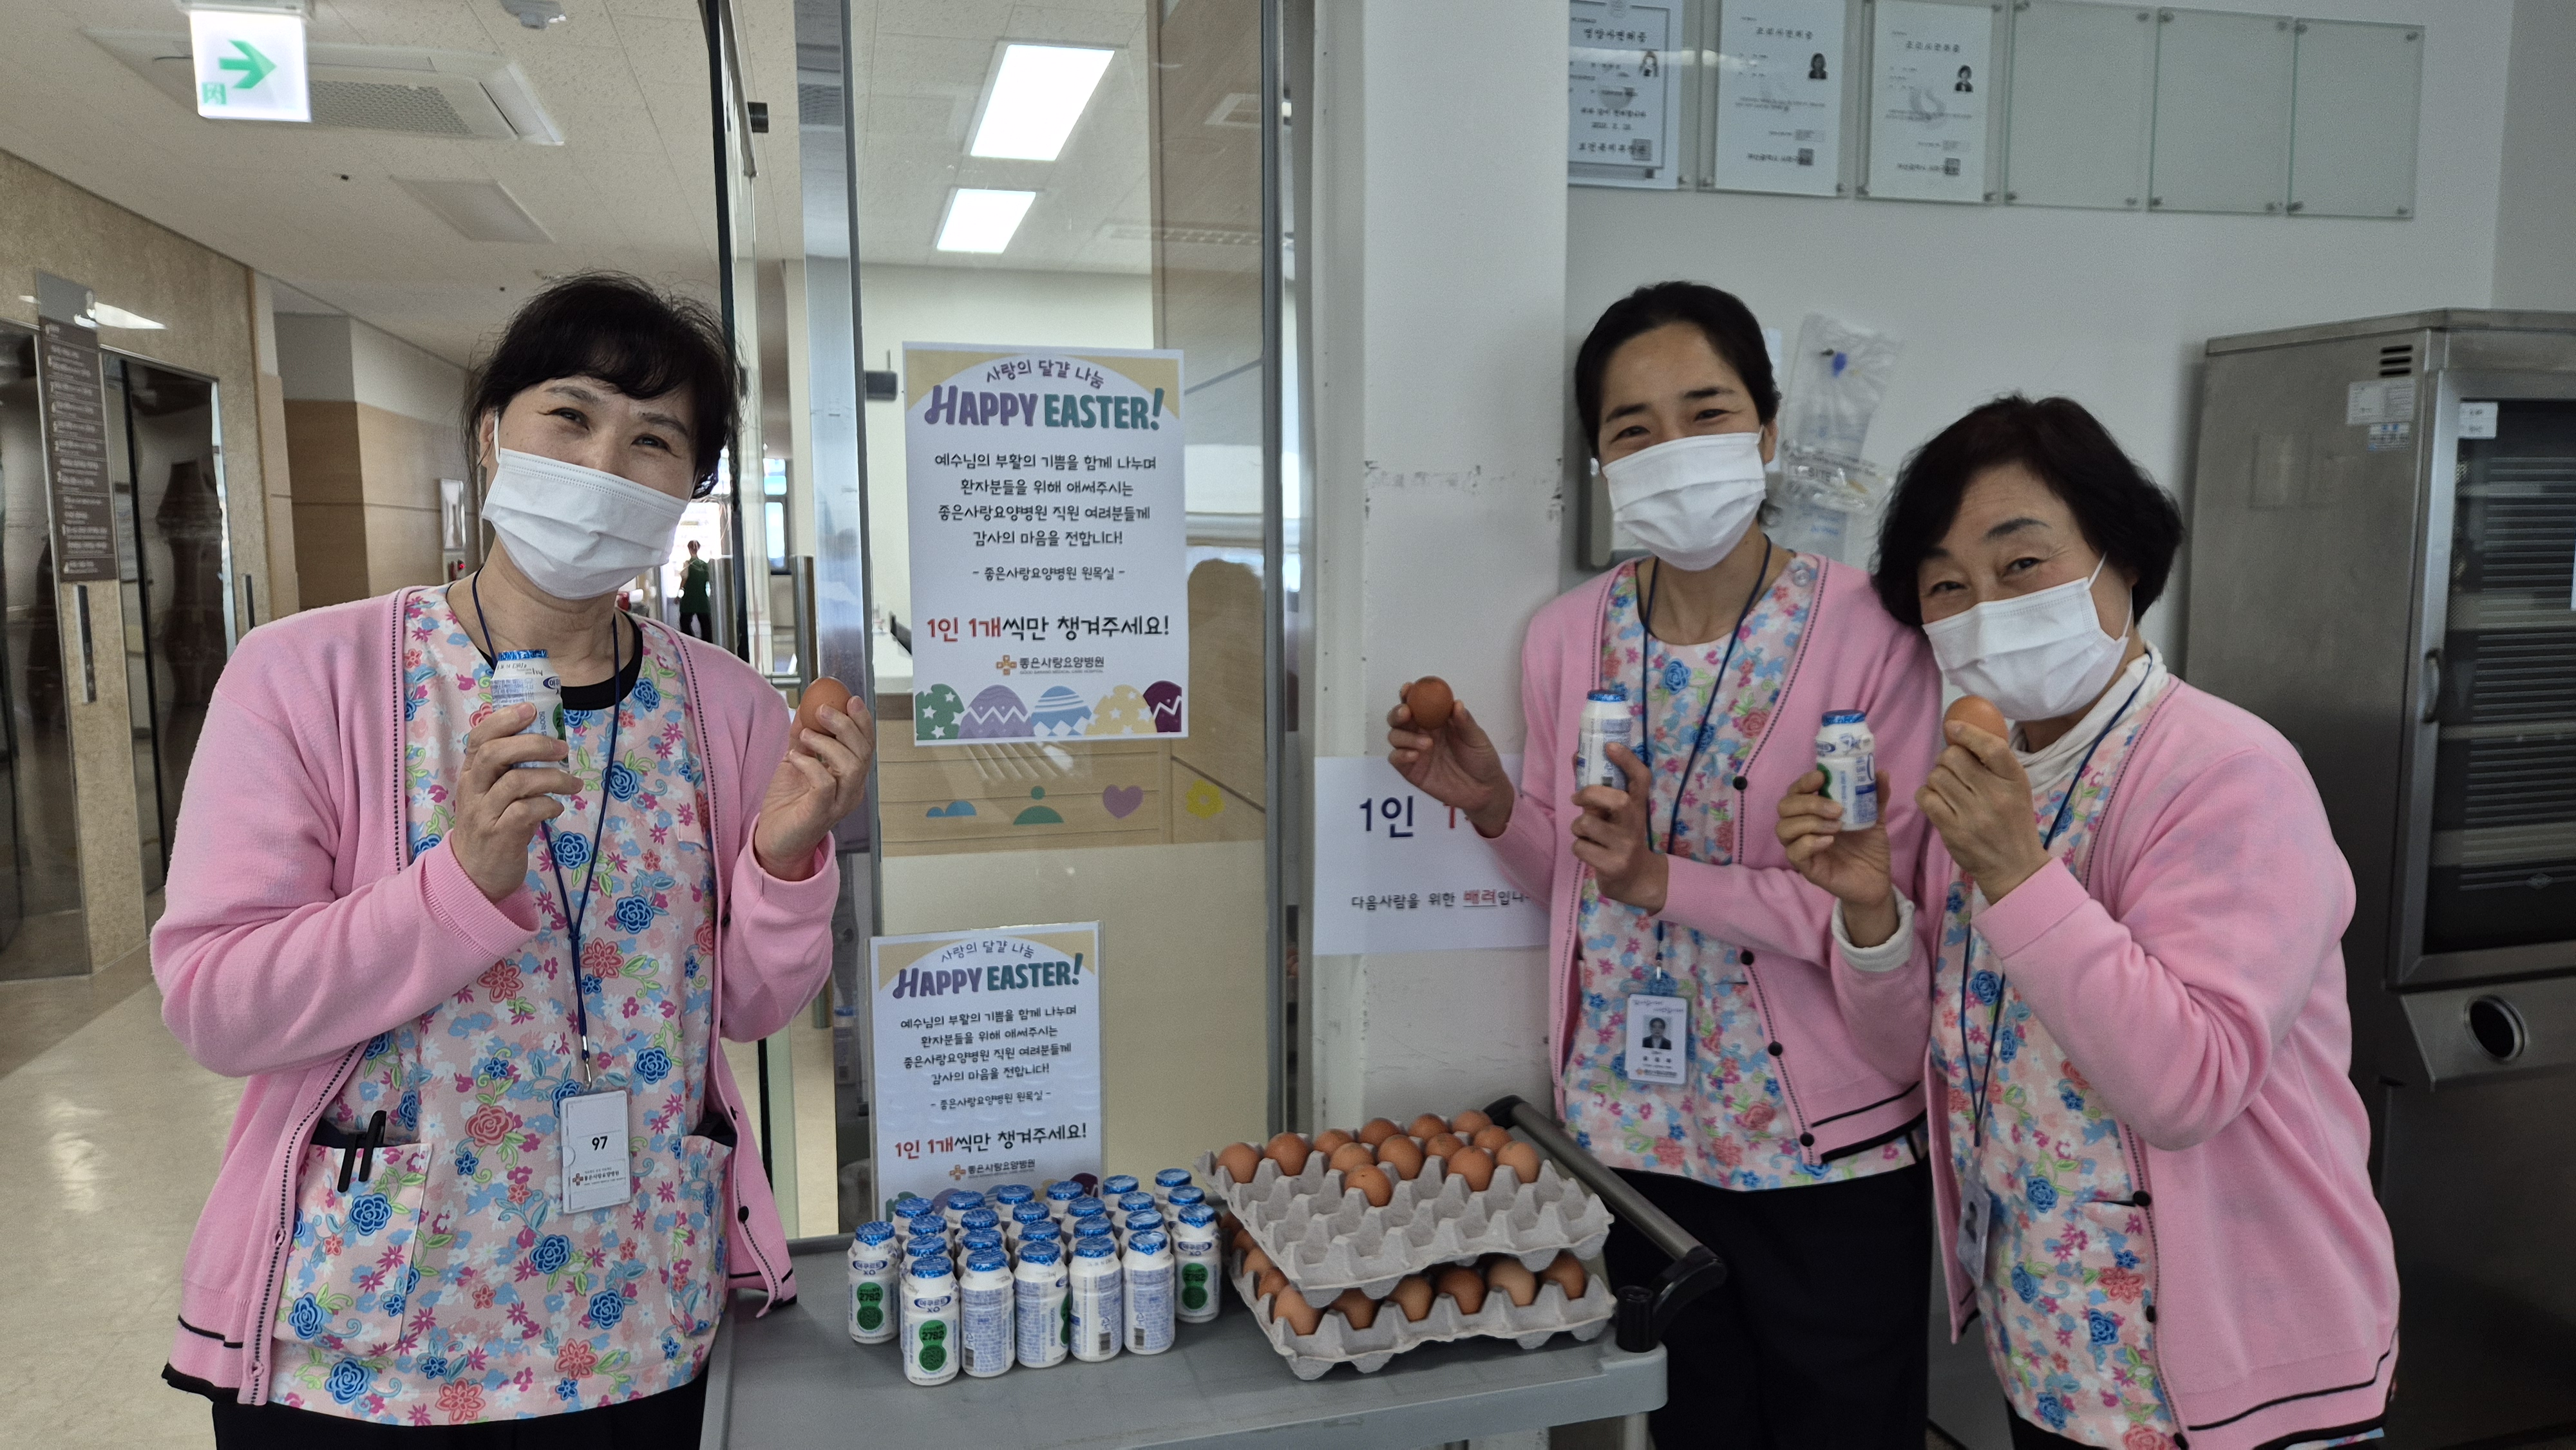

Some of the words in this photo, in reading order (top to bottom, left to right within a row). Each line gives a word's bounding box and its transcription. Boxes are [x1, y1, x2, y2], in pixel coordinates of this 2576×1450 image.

[987, 359, 1032, 383] 사랑의
[1038, 359, 1071, 379] 달걀
[1075, 366, 1104, 390] 나눔
[924, 384, 1038, 426] HAPPY
[1044, 388, 1165, 431] EASTER!
[934, 453, 990, 469] 예수님의
[996, 453, 1036, 470] 부활의
[1041, 454, 1079, 471] 기쁨을
[1084, 455, 1112, 471] 함께
[1117, 455, 1156, 471] 나누며
[961, 478, 1028, 496] 환자분들을
[1034, 480, 1061, 494] 위해
[1066, 480, 1134, 497] 애써주시는
[938, 504, 1047, 522] 좋은사랑요양병원
[1052, 505, 1079, 522] 직원
[973, 531, 1015, 547] 감사의
[1021, 530, 1060, 547] 마음을
[1065, 531, 1123, 547] 전합니다!
[984, 566, 1077, 581] 좋은사랑요양병원
[1081, 566, 1114, 581] 원목실
[927, 617, 958, 643] 1인
[969, 616, 1050, 641] 1개씩만
[1057, 615, 1169, 641] 챙겨주세요!
[1019, 656, 1104, 670] 좋은사랑요양병원
[1359, 795, 1414, 838] 1인
[1352, 892, 1420, 911] 다음사람을
[1428, 892, 1456, 907] 위한
[1463, 889, 1530, 906] 배려입니
[940, 941, 978, 963] 사랑의
[982, 940, 1008, 954] 달걀
[1011, 943, 1034, 959] 나눔
[893, 967, 983, 999] HAPPY
[987, 952, 1084, 991] EASTER!
[900, 1015, 945, 1030] 예수님의
[948, 1012, 981, 1026] 부활의
[984, 1009, 1014, 1023] 기쁨을
[1018, 1007, 1041, 1021] 함께
[1045, 1004, 1077, 1017] 나누며
[921, 1031, 974, 1049] 환자분들을
[978, 1030, 1001, 1042] 위해
[1004, 1025, 1058, 1039] 애써주시는
[903, 1049, 990, 1069] 좋은사랑요양병원
[994, 1047, 1015, 1060] 직원
[931, 1071, 964, 1086] 감사의
[968, 1067, 999, 1081] 마음을
[1003, 1062, 1050, 1078] 전합니다!
[940, 1093, 1013, 1111] 좋은사랑요양병원
[1016, 1090, 1043, 1103] 원목실
[592, 1136, 608, 1151] 97
[895, 1140, 920, 1160] 1인
[927, 1133, 992, 1154] 1개씩만
[998, 1122, 1086, 1149] 챙겨주세요!
